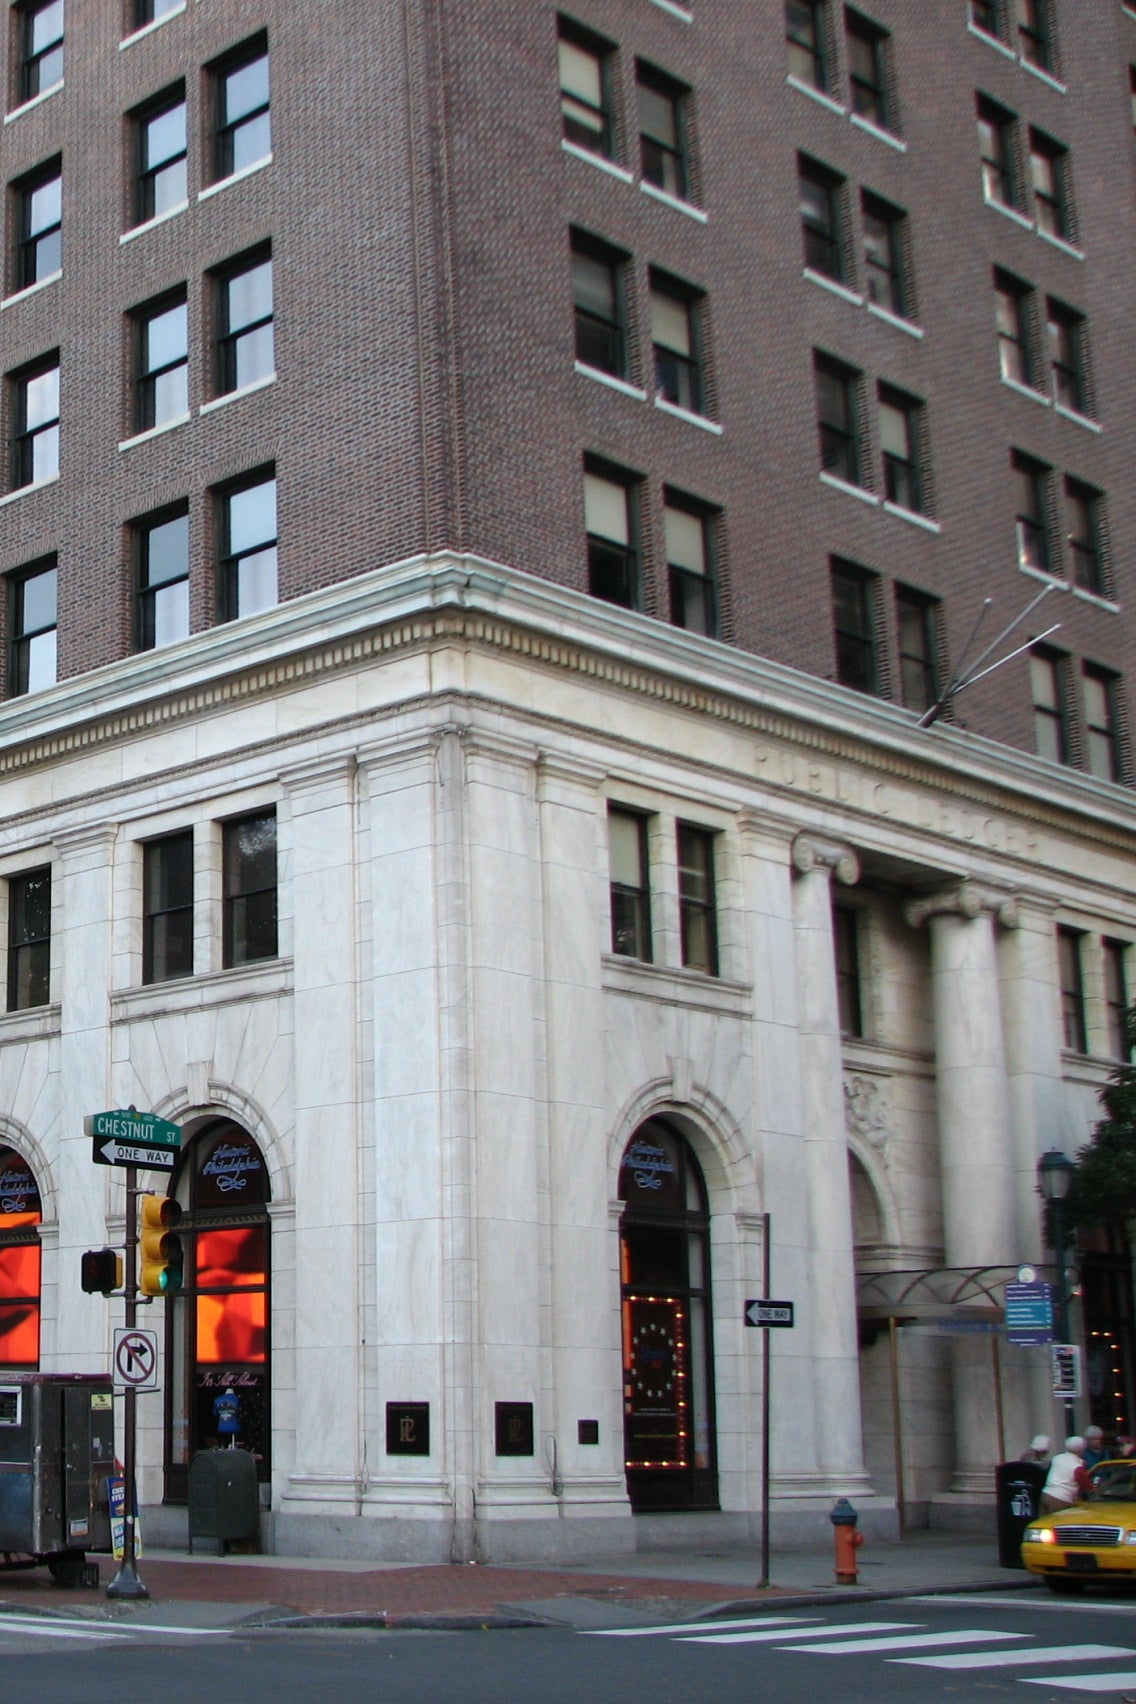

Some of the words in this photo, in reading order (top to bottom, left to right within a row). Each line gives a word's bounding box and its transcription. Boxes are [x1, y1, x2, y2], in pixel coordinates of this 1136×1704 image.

[97, 1117, 155, 1140] CHESTNUT
[166, 1131, 176, 1143] ST
[117, 1147, 140, 1160] ONE
[145, 1150, 169, 1163] WAY
[758, 1308, 772, 1320] ONE
[773, 1308, 789, 1320] WAY
